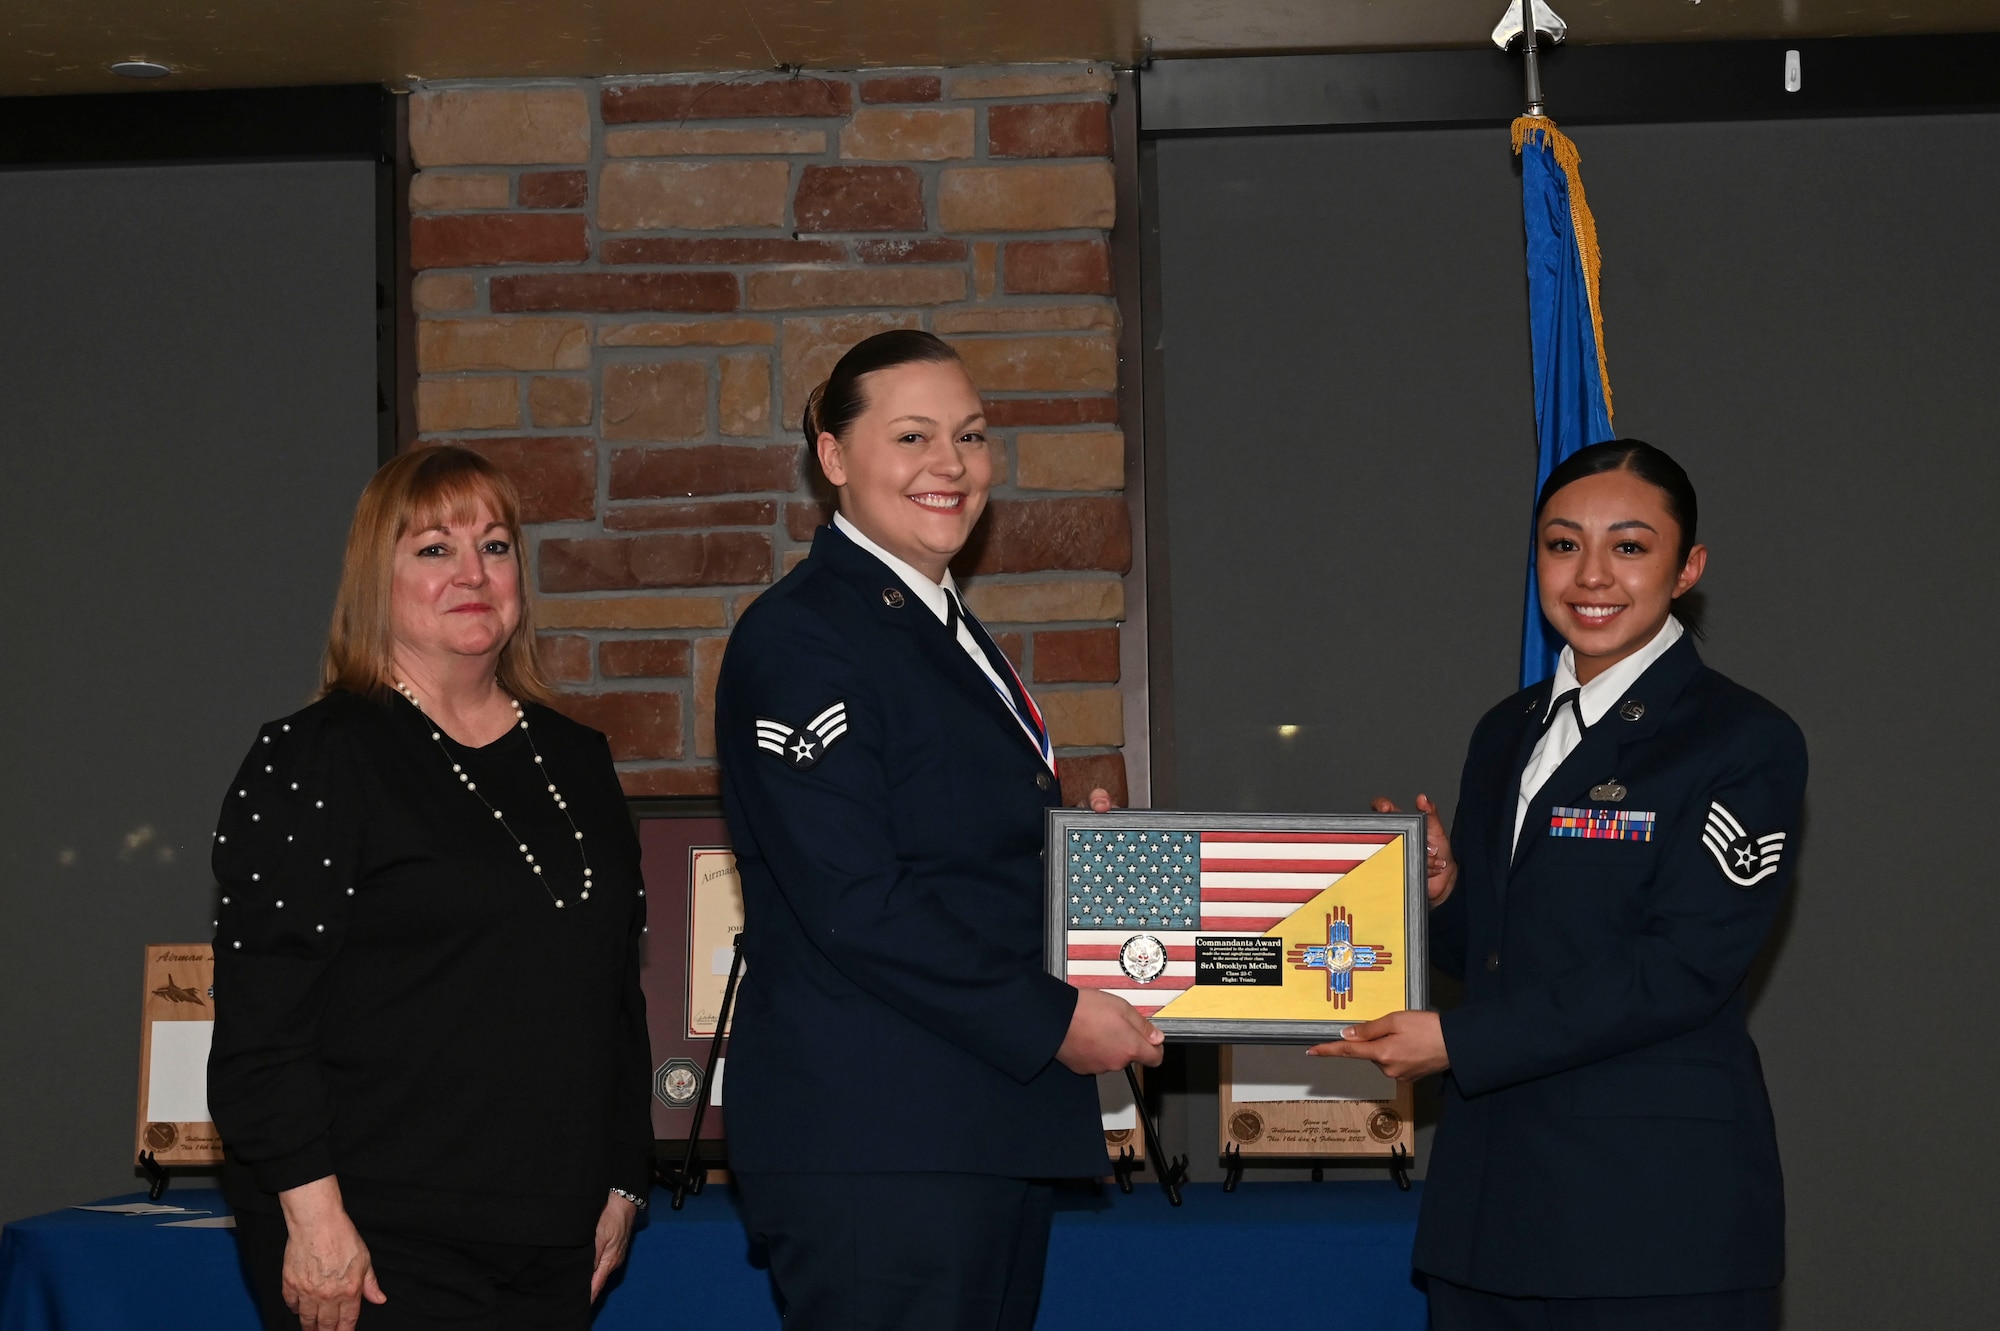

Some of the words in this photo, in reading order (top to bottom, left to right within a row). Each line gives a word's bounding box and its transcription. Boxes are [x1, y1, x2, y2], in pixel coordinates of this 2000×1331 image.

[701, 866, 736, 886] Airman
[1196, 938, 1253, 946] Commandants
[1255, 938, 1280, 946] Award
[156, 951, 203, 962] Airman
[1216, 962, 1248, 970] Brooklyn
